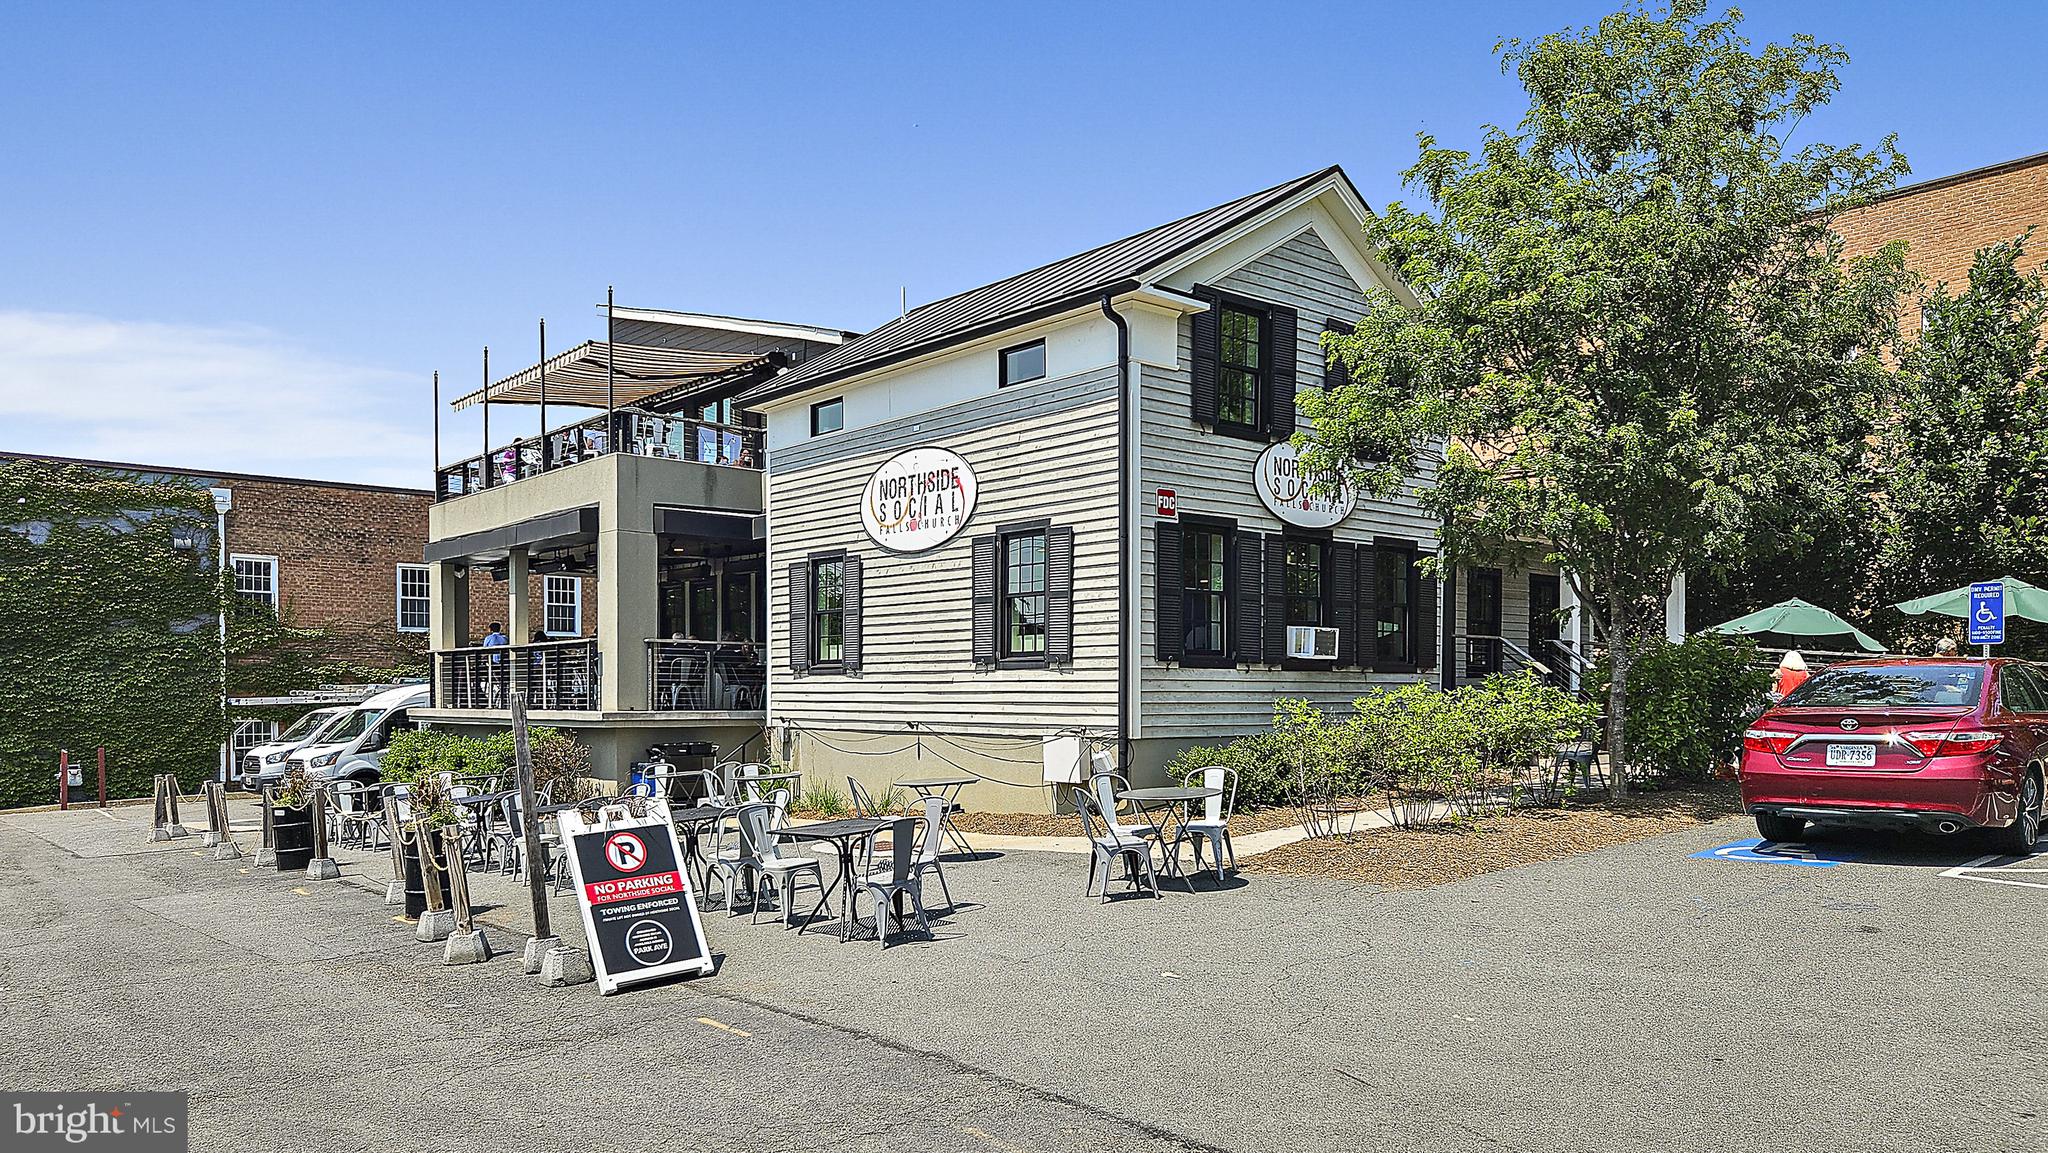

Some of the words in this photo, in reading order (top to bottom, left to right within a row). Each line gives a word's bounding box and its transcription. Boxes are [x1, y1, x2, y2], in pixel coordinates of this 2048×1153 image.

[880, 467, 959, 501] NORTHSIDE
[880, 491, 959, 522] SOCIAL
[1158, 495, 1175, 510] FDC
[1274, 500, 1302, 509] FALLS
[880, 521, 910, 535] FALLS
[917, 514, 960, 530] CHURCH
[594, 883, 616, 896] NO
[617, 874, 674, 892] PARKING
[597, 894, 612, 903] FOR
[612, 888, 651, 900] NORTHSIDE
[651, 885, 676, 895] SOCIAL
[600, 904, 637, 916] TOWING
[636, 897, 679, 911] ENFORCED
[633, 945, 654, 955] PARK
[653, 942, 668, 951] AVE
